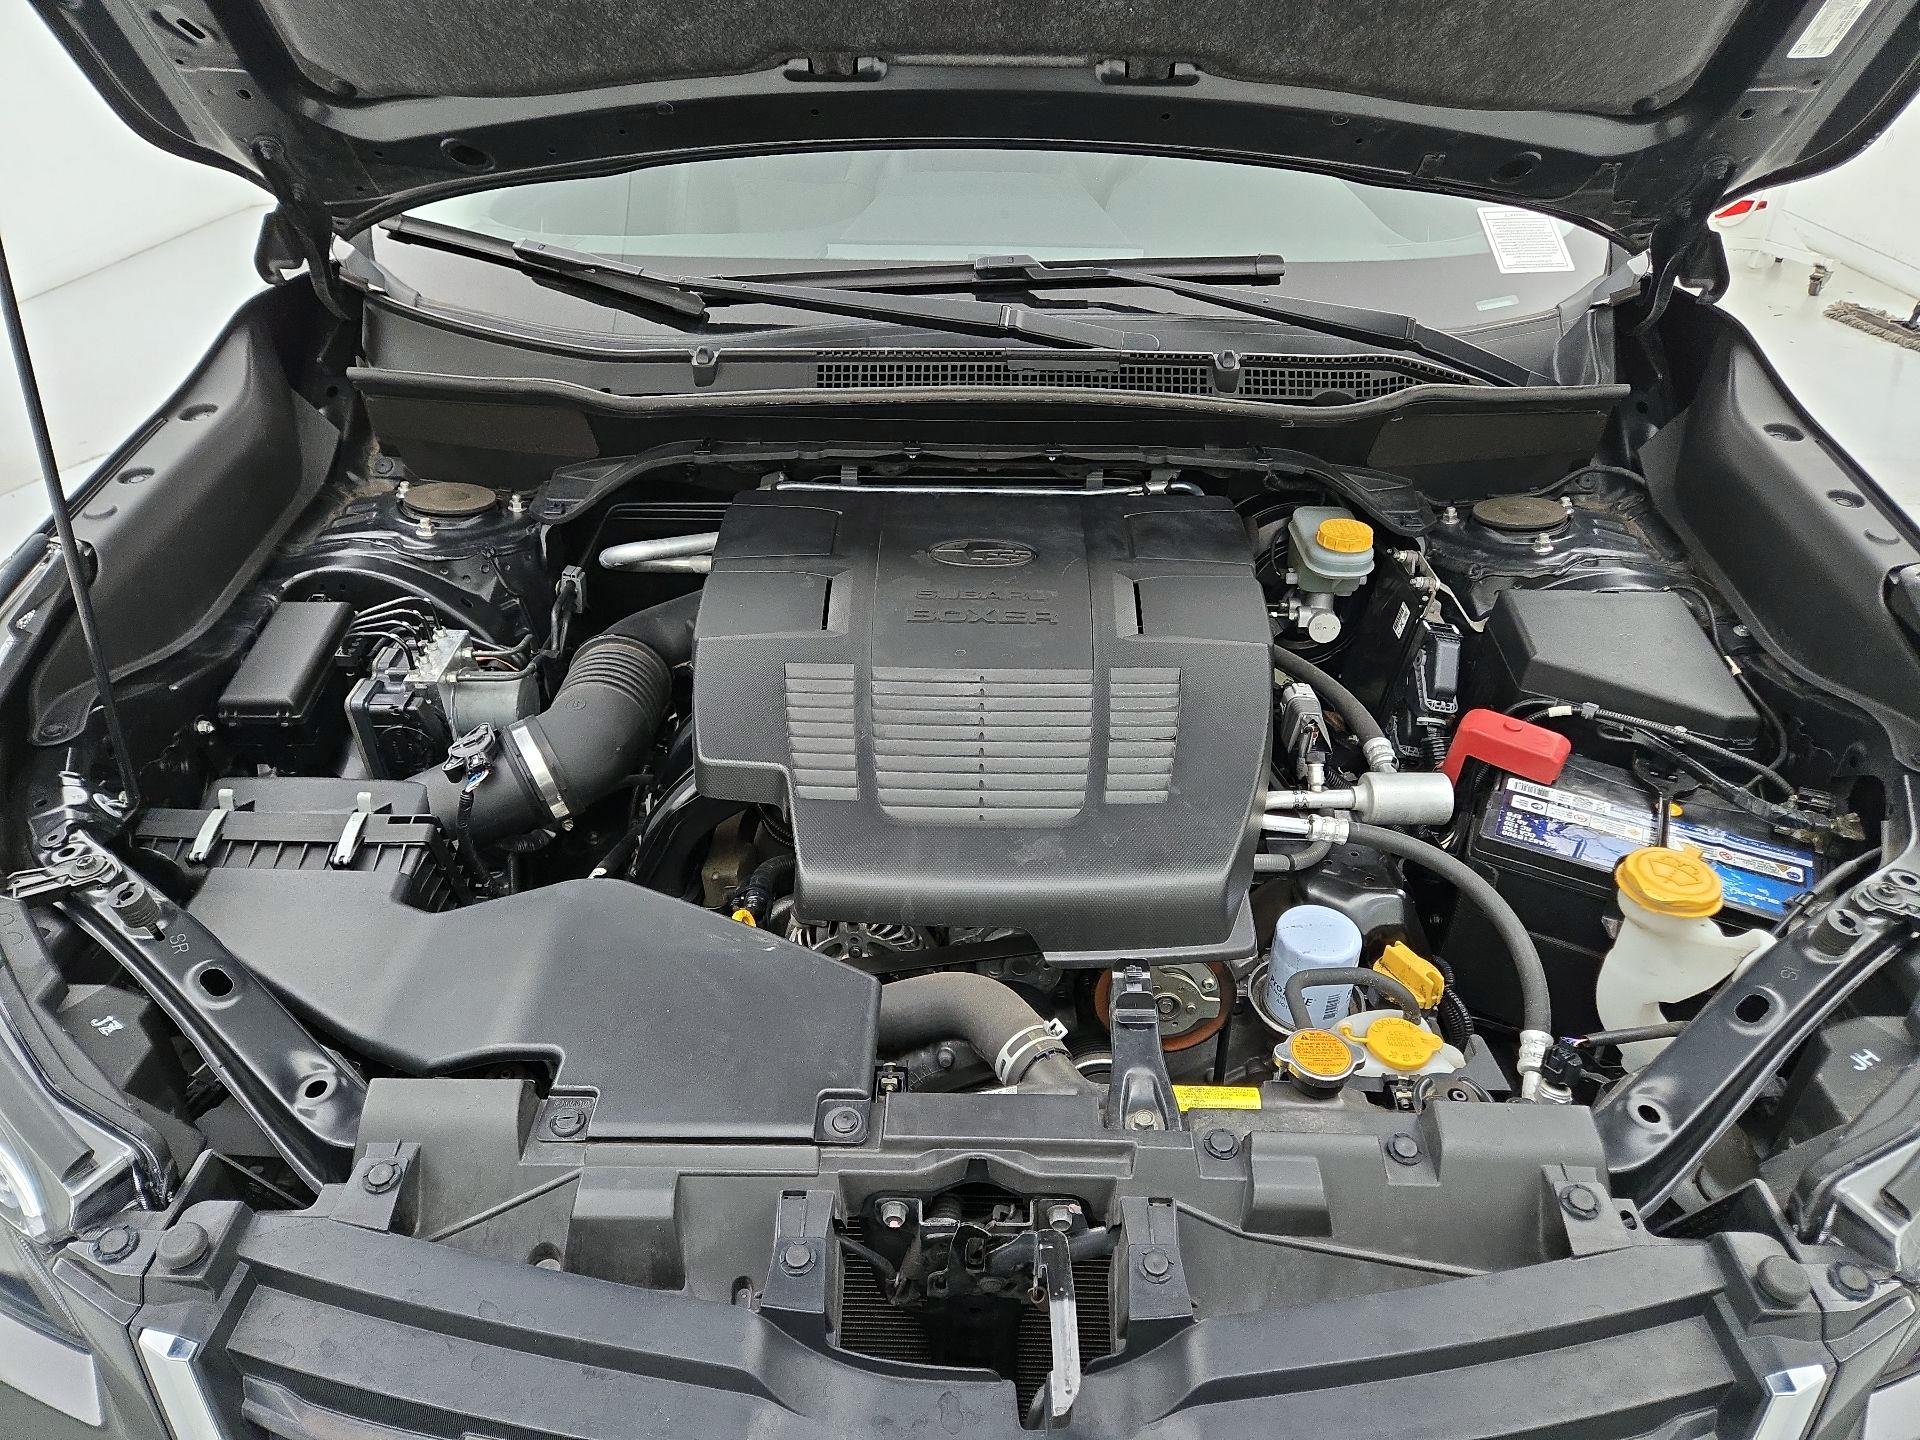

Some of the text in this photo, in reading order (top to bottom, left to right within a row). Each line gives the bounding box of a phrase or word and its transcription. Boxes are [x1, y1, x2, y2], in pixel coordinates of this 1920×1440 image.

[915, 588, 1058, 601] SUBARU
[906, 608, 1058, 625] BOXER
[1849, 1048, 1881, 1071] JH
